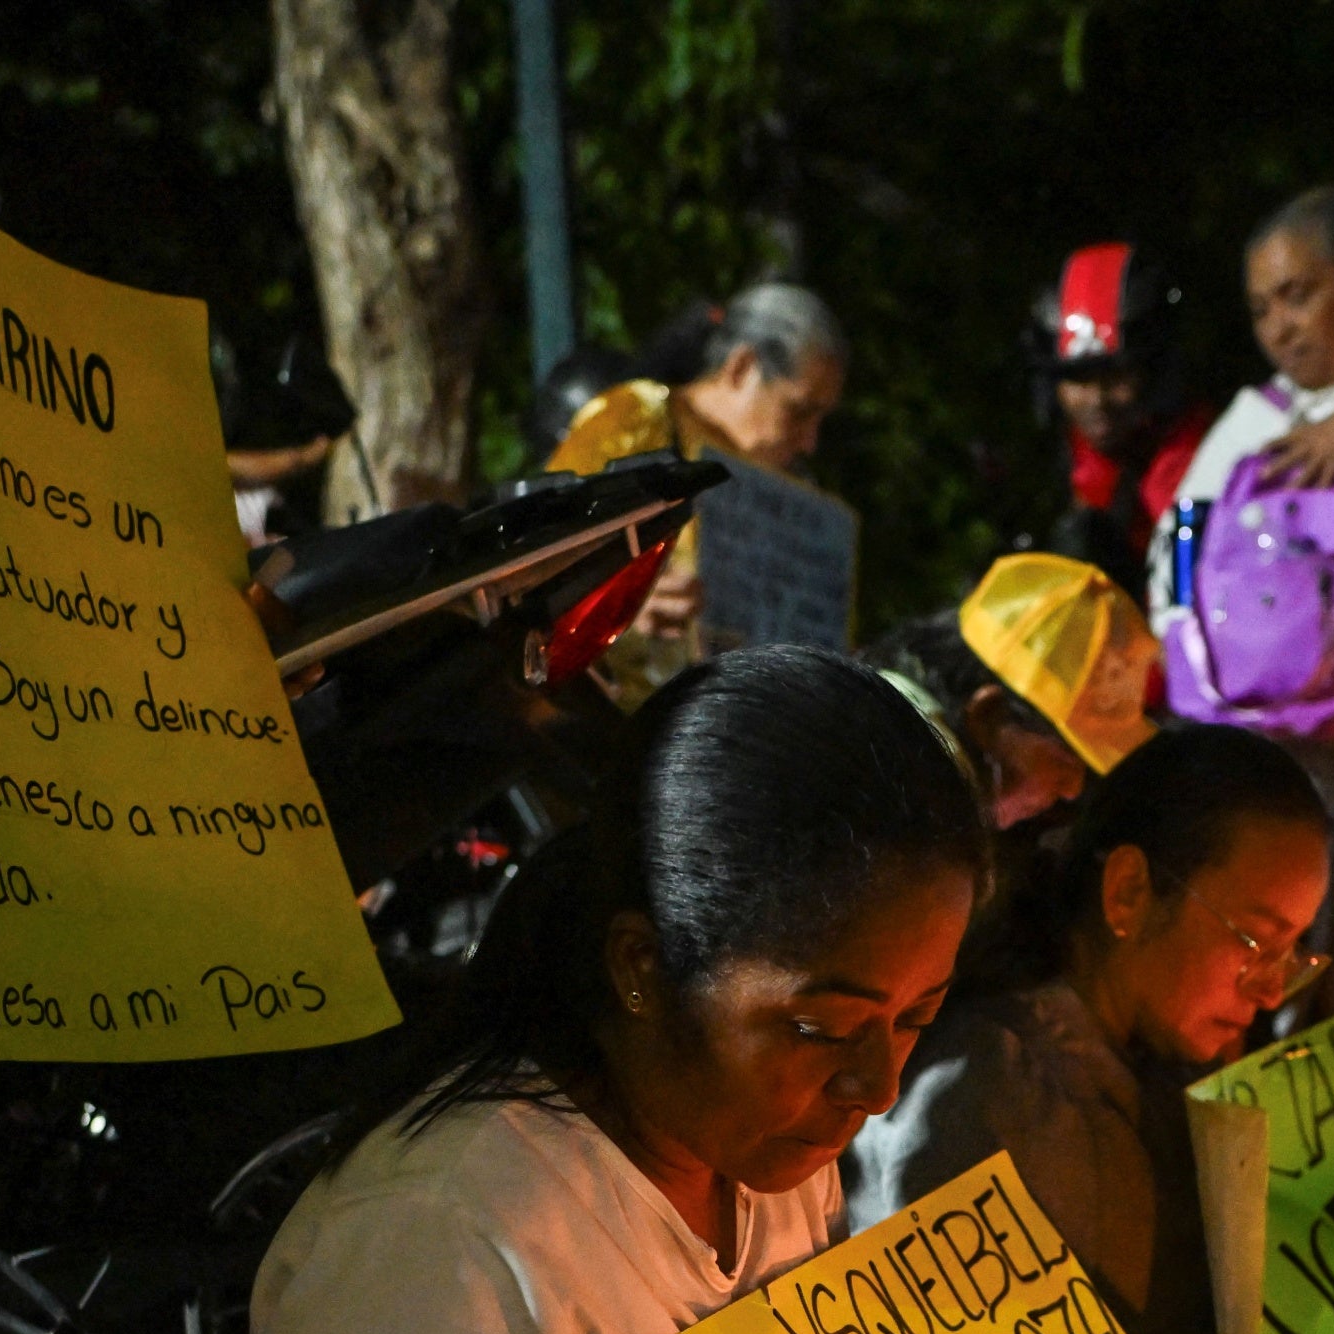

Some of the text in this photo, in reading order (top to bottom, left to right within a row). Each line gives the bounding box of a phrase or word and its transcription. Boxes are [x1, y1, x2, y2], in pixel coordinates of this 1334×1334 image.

[0, 457, 36, 508] no
[43, 485, 92, 528] es
[113, 501, 163, 548] un
[157, 602, 185, 659] y
[64, 686, 115, 723] un
[128, 805, 156, 836] a
[169, 802, 324, 855] ninguna
[90, 989, 116, 1030] a
[128, 986, 178, 1028] mi
